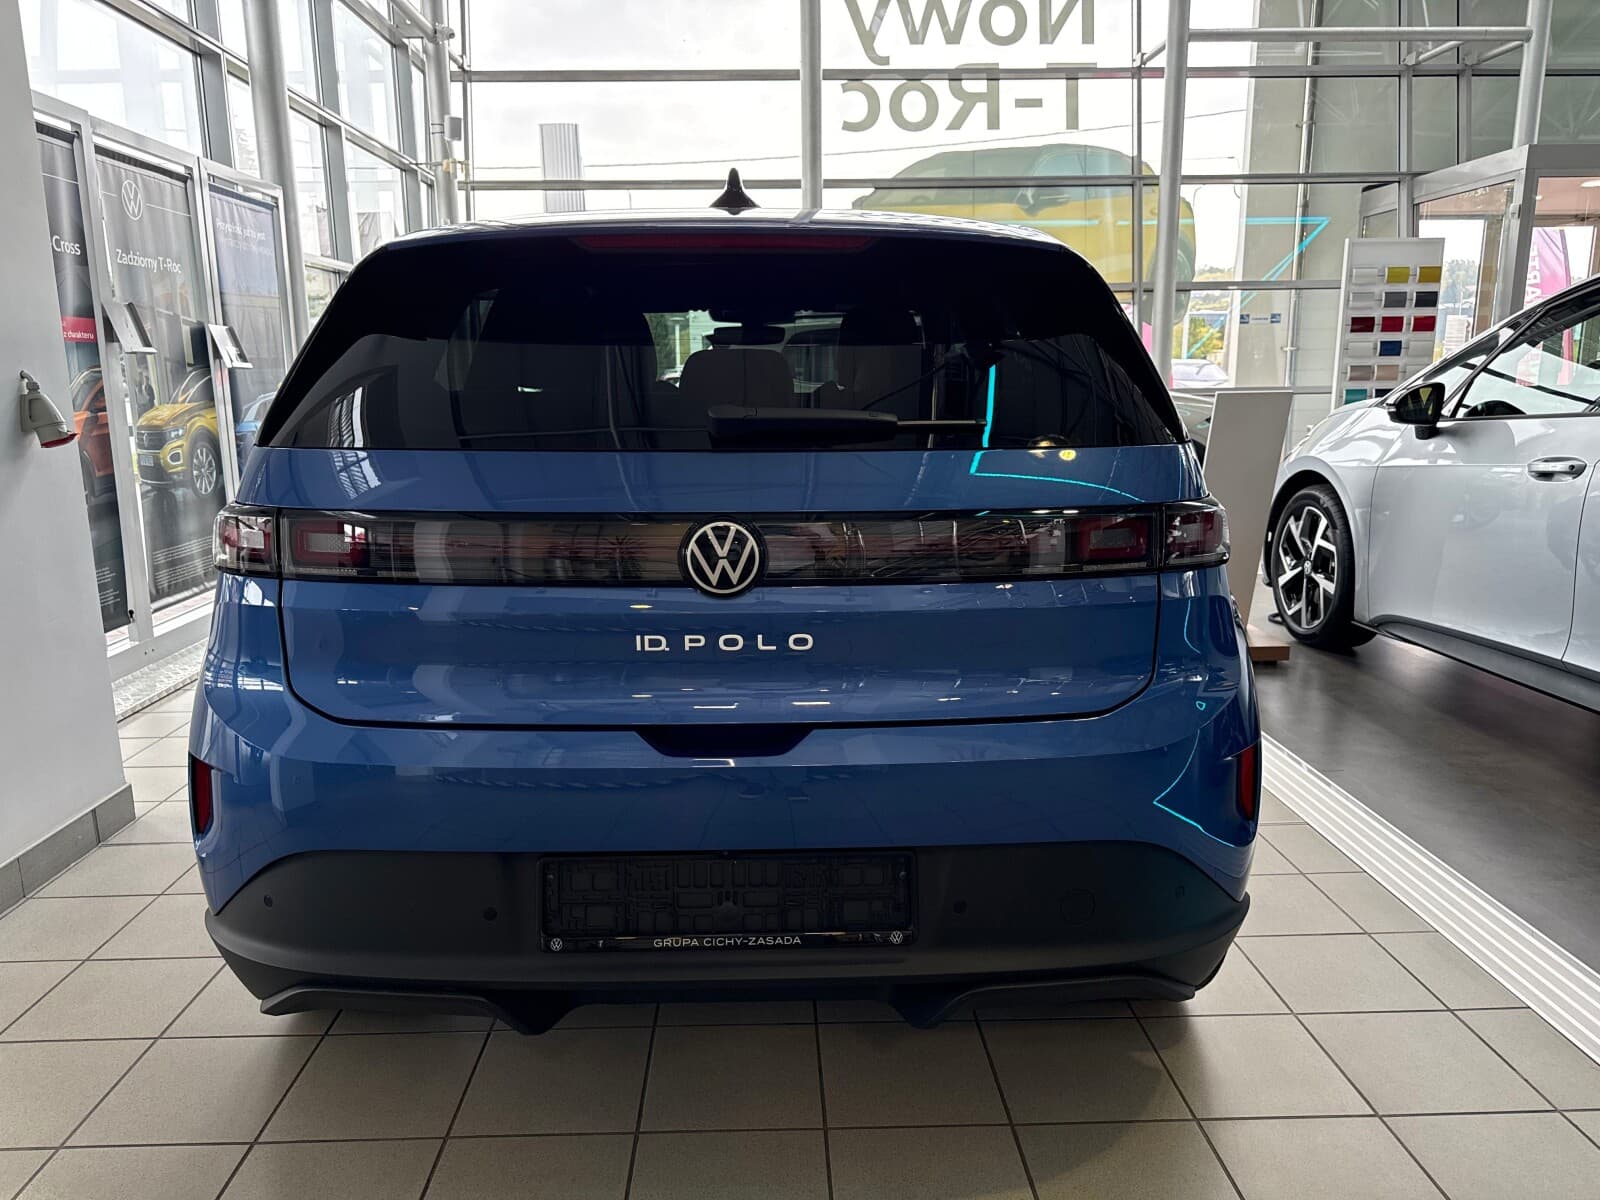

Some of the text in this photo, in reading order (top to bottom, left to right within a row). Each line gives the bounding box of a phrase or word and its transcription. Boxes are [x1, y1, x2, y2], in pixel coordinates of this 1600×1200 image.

[52, 235, 81, 256] Cross
[157, 256, 182, 273] T-Roc
[684, 633, 815, 651] POLO
[653, 935, 802, 948] GRUPA CICHY-ZASADA
